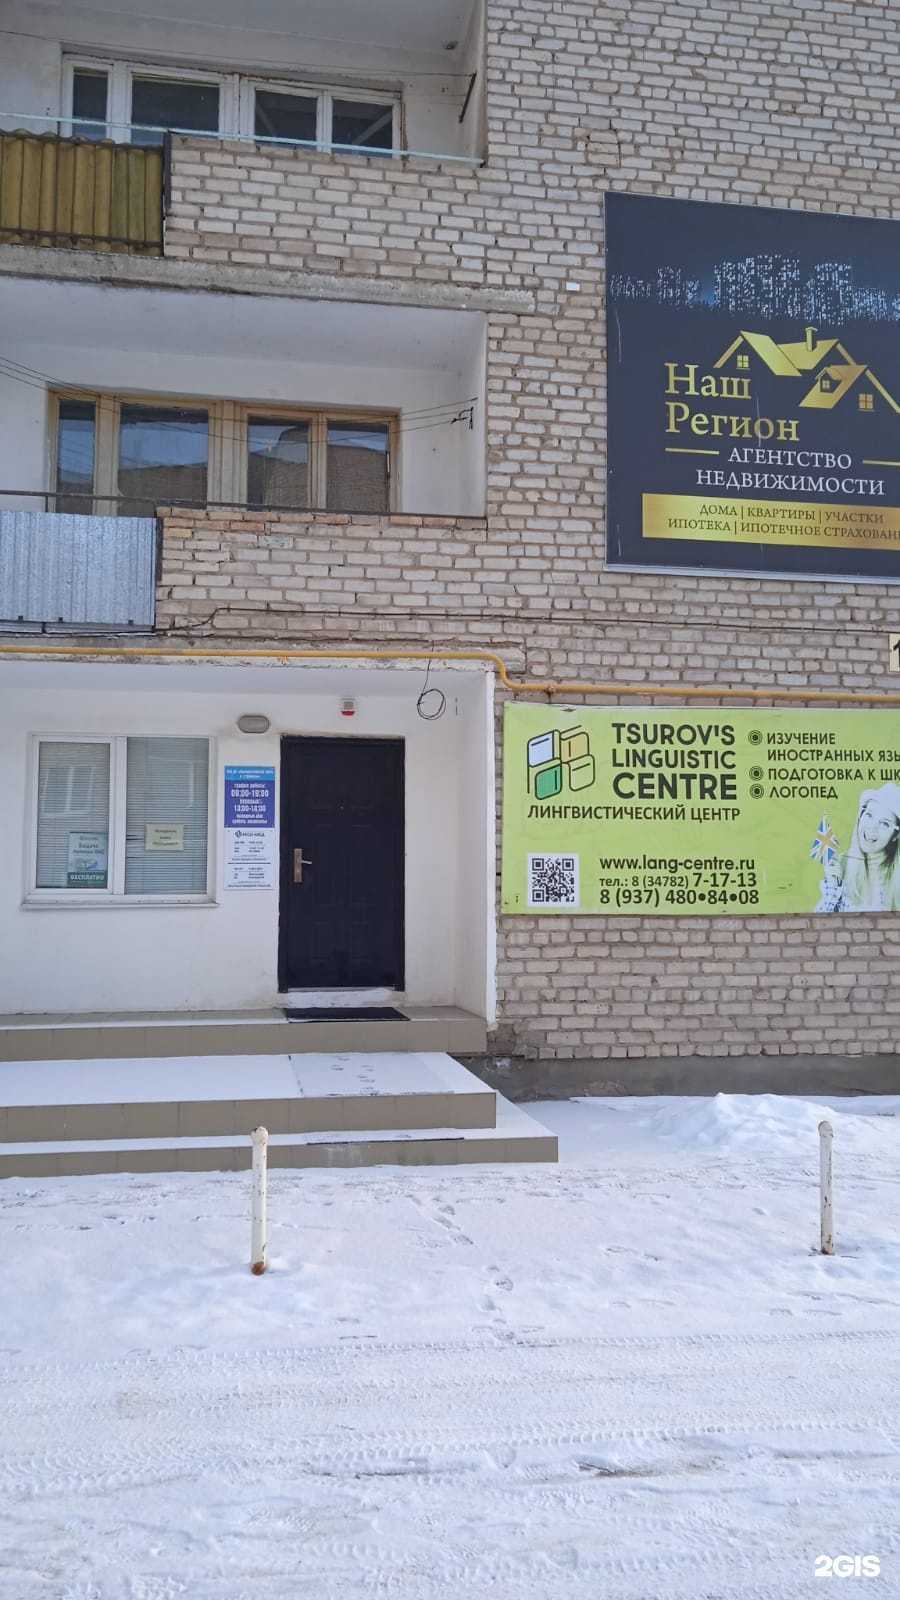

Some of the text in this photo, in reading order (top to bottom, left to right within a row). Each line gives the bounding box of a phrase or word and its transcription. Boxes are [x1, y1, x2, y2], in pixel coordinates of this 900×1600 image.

[664, 362, 752, 399] Наш
[664, 401, 800, 442] Регион
[728, 447, 852, 469] АГЕНТСТВО
[696, 469, 886, 496] НЕДВИЖИМОСТИ
[699, 504, 884, 524] ДОМА КВАРТИРЫ УЧАСТКИ
[668, 518, 900, 541] ИПОТЕКА ИПОТЕЧНОЕ СТРАХОВАН
[611, 723, 736, 746] TSUROV'S
[767, 732, 836, 745] ИЗУЧЕНИЕ
[612, 748, 736, 770] LINGUISTIC
[767, 749, 874, 762] ИНОСТРАННЫХ
[768, 768, 863, 781] ПОДГОТОВКА
[868, 769, 876, 780] К
[612, 772, 737, 800] CENTRE
[769, 786, 838, 799] ЛОГОПЕД
[528, 803, 740, 823] ЛИНГВИСТИЧЕСКИЙ ЦЕНТР
[599, 854, 755, 873] www.lang-centre.ru
[599, 873, 757, 889] тел.: 8 (34782) 7-17-13
[600, 889, 610, 904] 8
[616, 888, 660, 907] (937)
